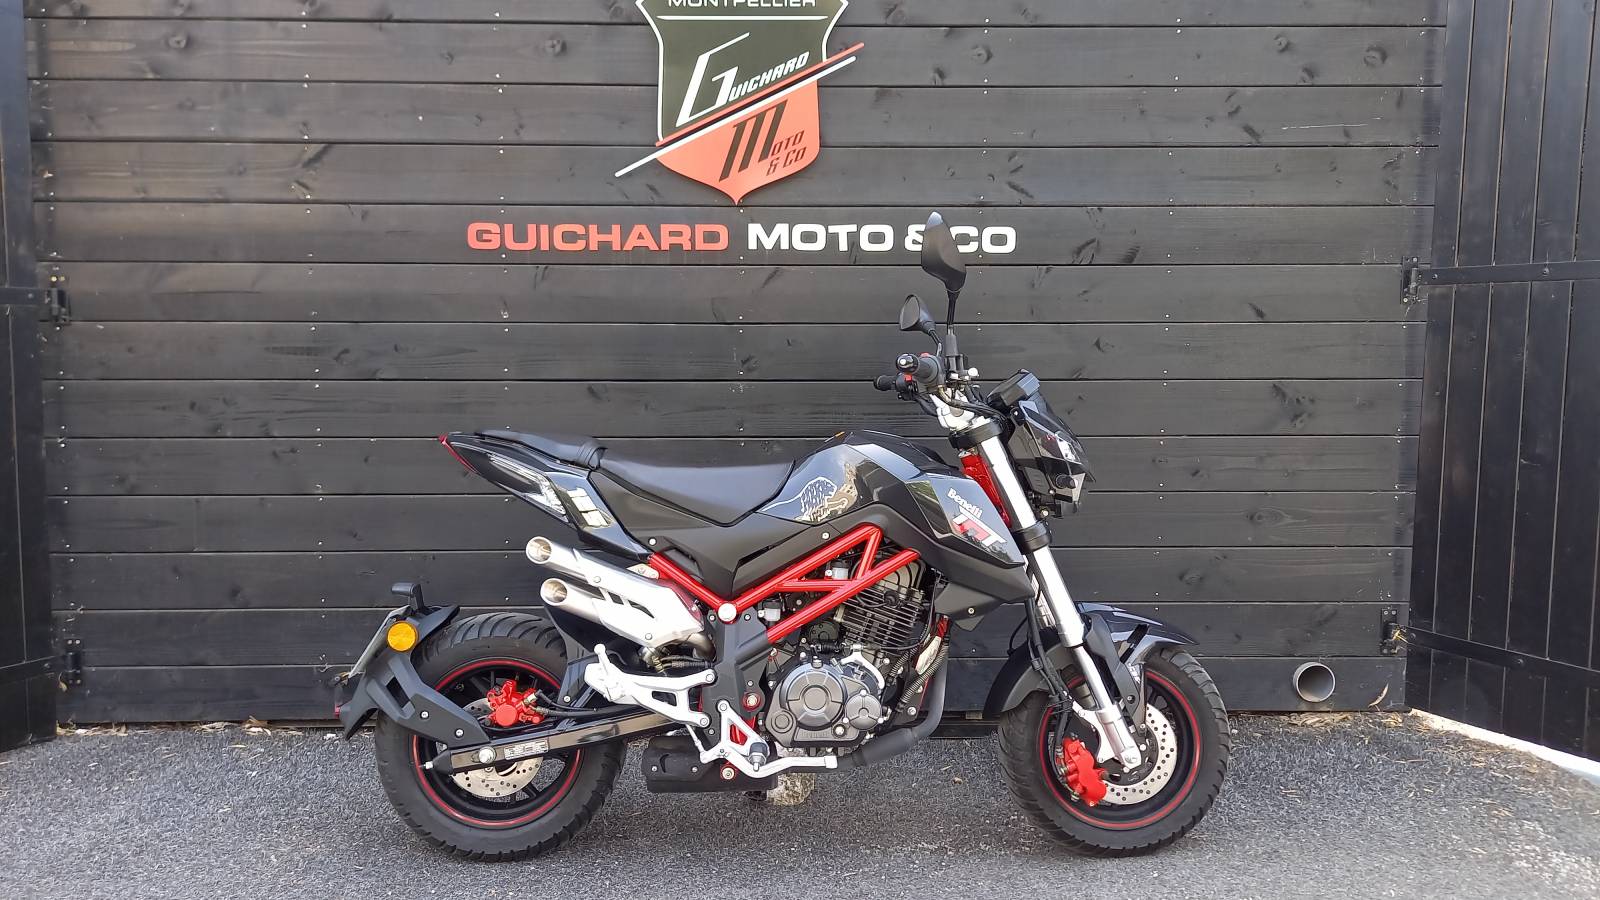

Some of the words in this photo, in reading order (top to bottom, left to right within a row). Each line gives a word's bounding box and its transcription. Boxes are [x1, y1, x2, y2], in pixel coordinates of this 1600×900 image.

[782, 146, 807, 168] CO
[467, 222, 729, 251] GUICHARD
[748, 223, 894, 252] MOTO
[949, 225, 1017, 254] CO
[947, 487, 983, 519] Benelli
